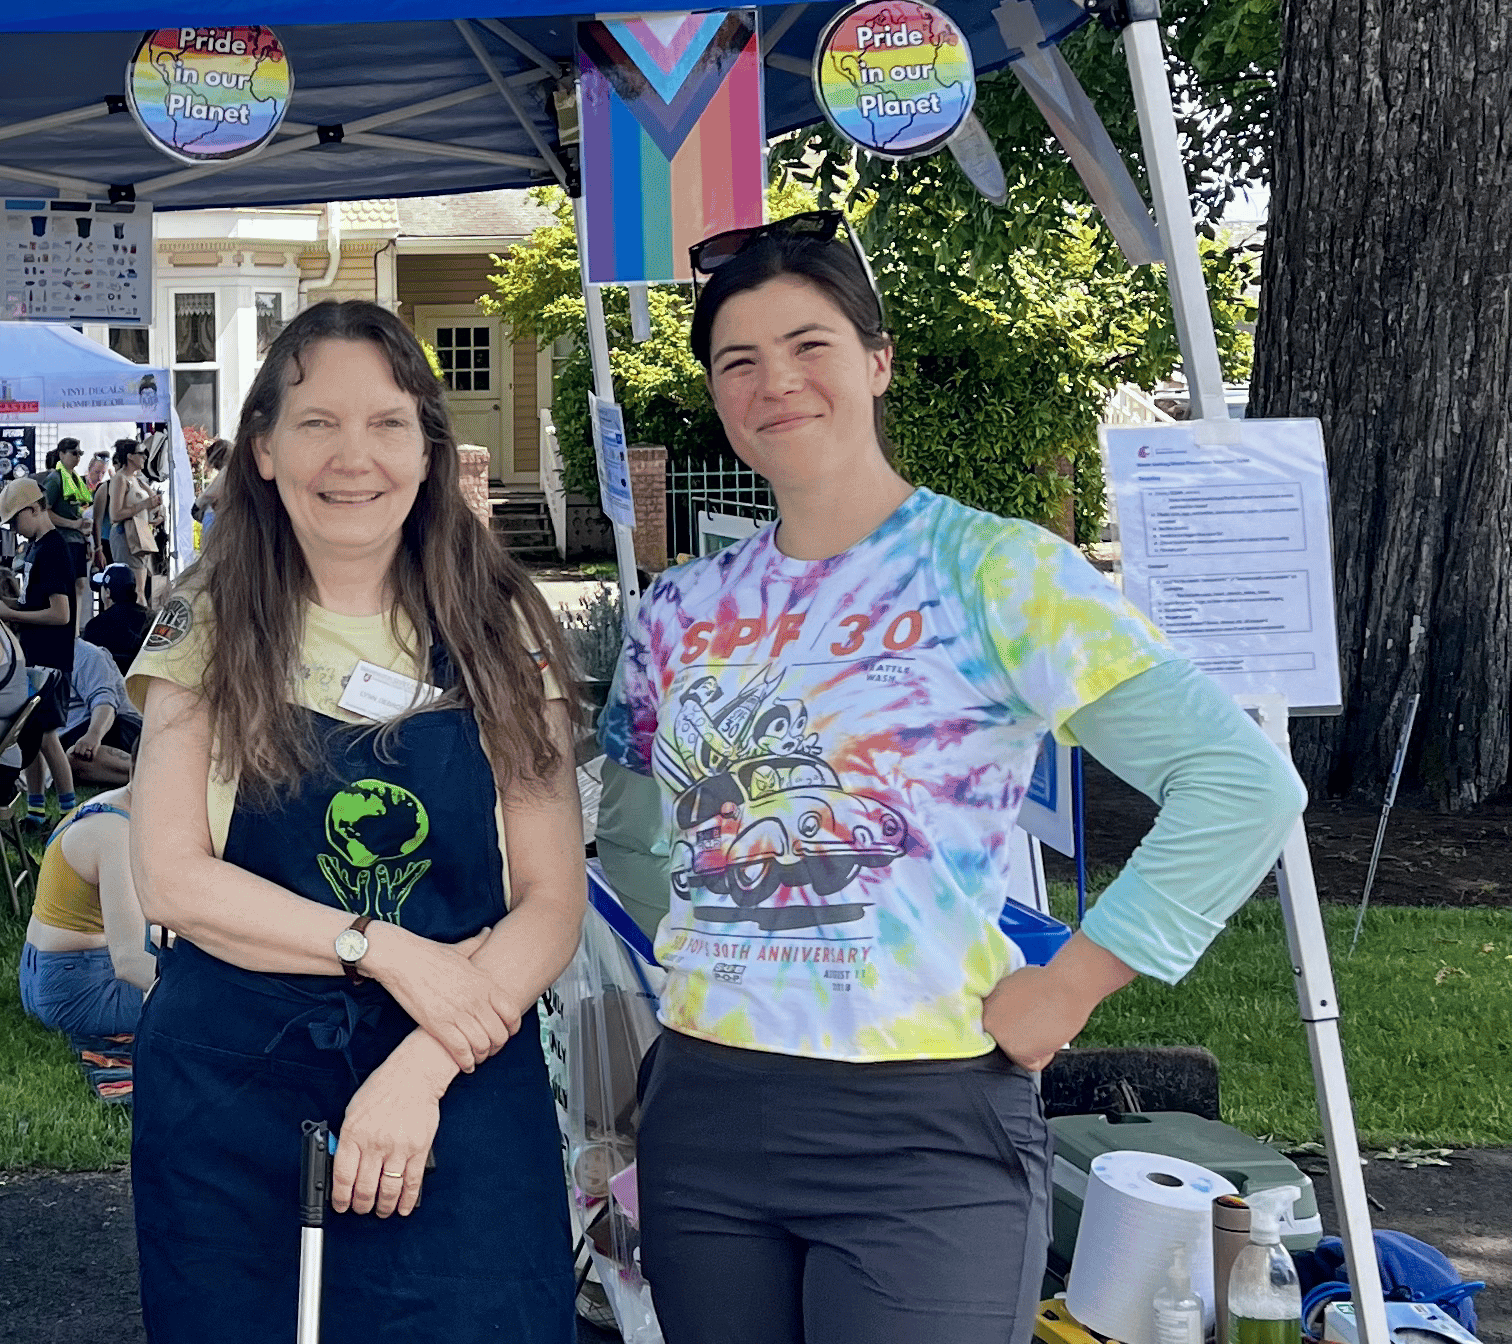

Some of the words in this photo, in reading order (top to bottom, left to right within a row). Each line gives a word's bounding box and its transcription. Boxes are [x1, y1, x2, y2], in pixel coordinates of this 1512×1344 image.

[179, 27, 247, 55] Pride
[856, 23, 924, 50] Pride
[174, 61, 199, 84] in
[204, 69, 250, 91] our
[859, 61, 885, 84] in
[890, 63, 934, 81] our
[167, 93, 251, 126] Planet
[860, 93, 941, 118] Planet
[61, 387, 85, 396] VINYL
[89, 385, 125, 395] DECALS
[62, 400, 88, 409] HOME
[91, 398, 124, 407] DECOR
[679, 612, 806, 664] SPF
[829, 609, 923, 657] 30
[721, 719, 740, 739] 30
[713, 942, 751, 960] 30TH
[757, 945, 873, 964] ANNIVERSARY
